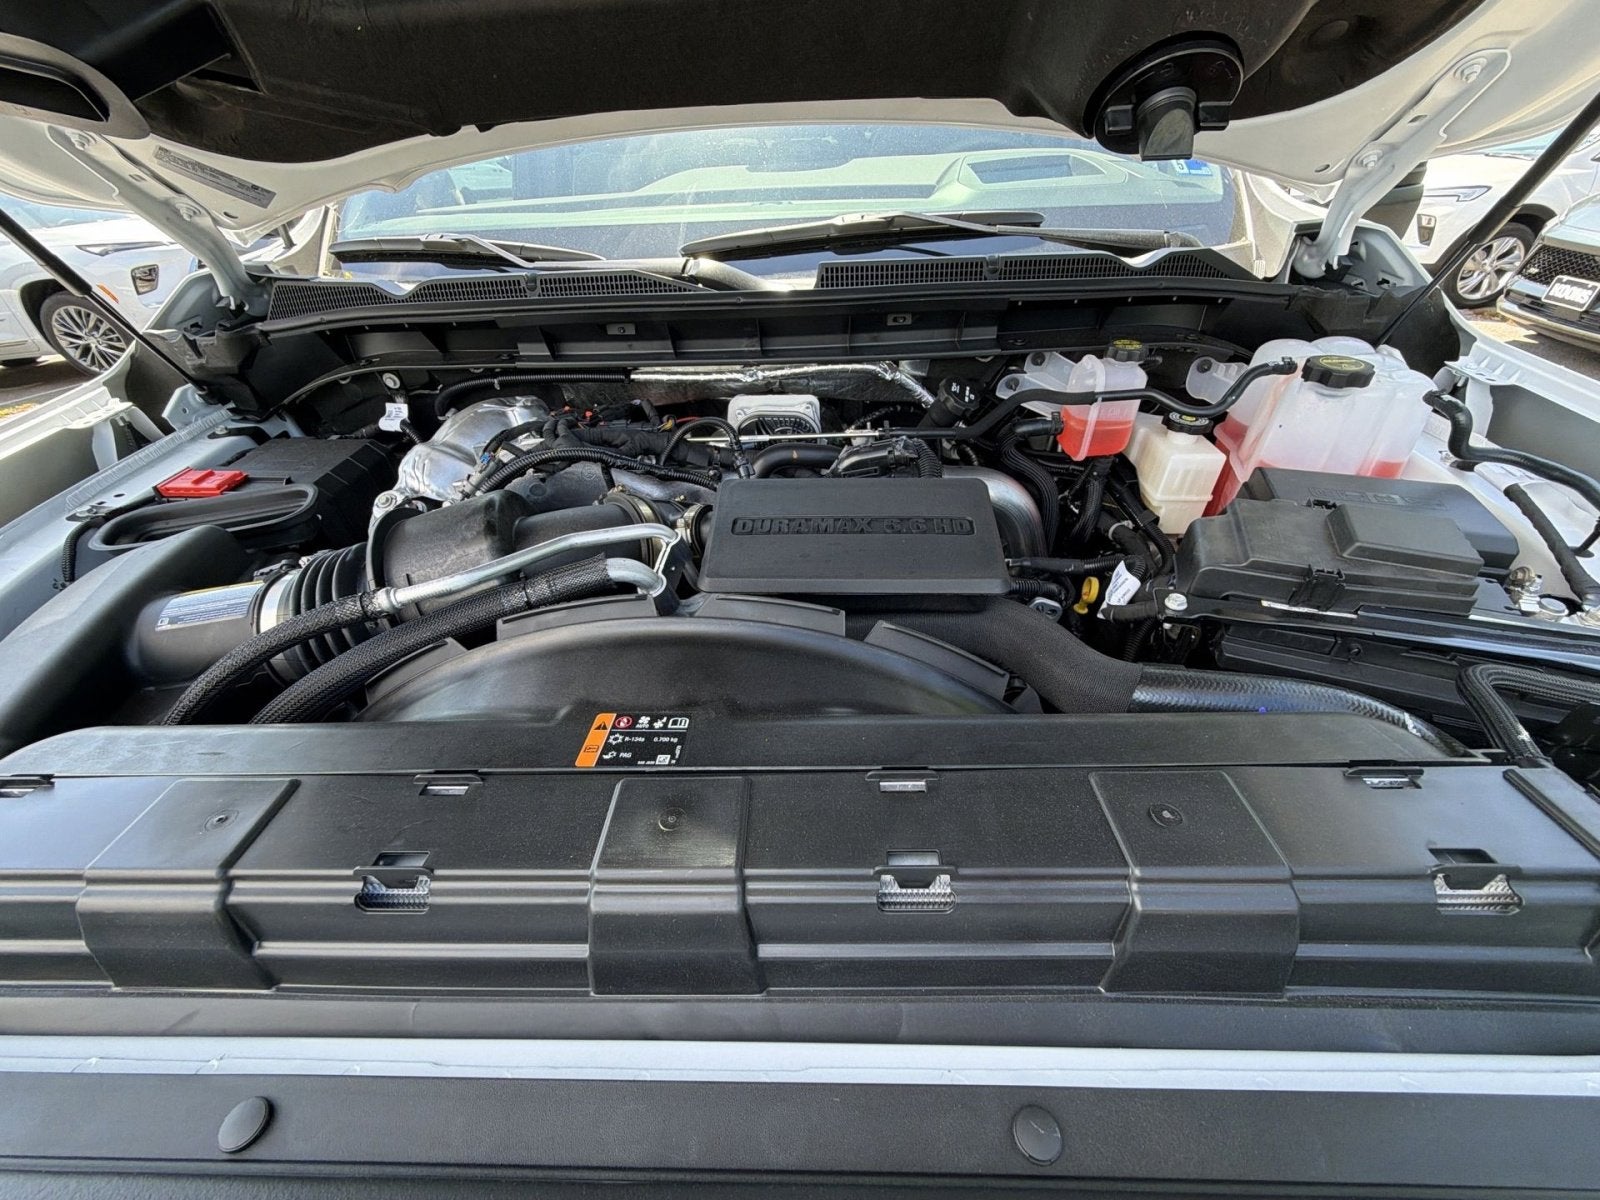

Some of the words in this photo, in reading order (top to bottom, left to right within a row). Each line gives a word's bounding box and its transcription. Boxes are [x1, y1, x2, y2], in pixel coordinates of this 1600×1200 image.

[735, 518, 872, 533] DURAMAX
[883, 519, 928, 533] 6.6
[934, 519, 973, 533] HD
